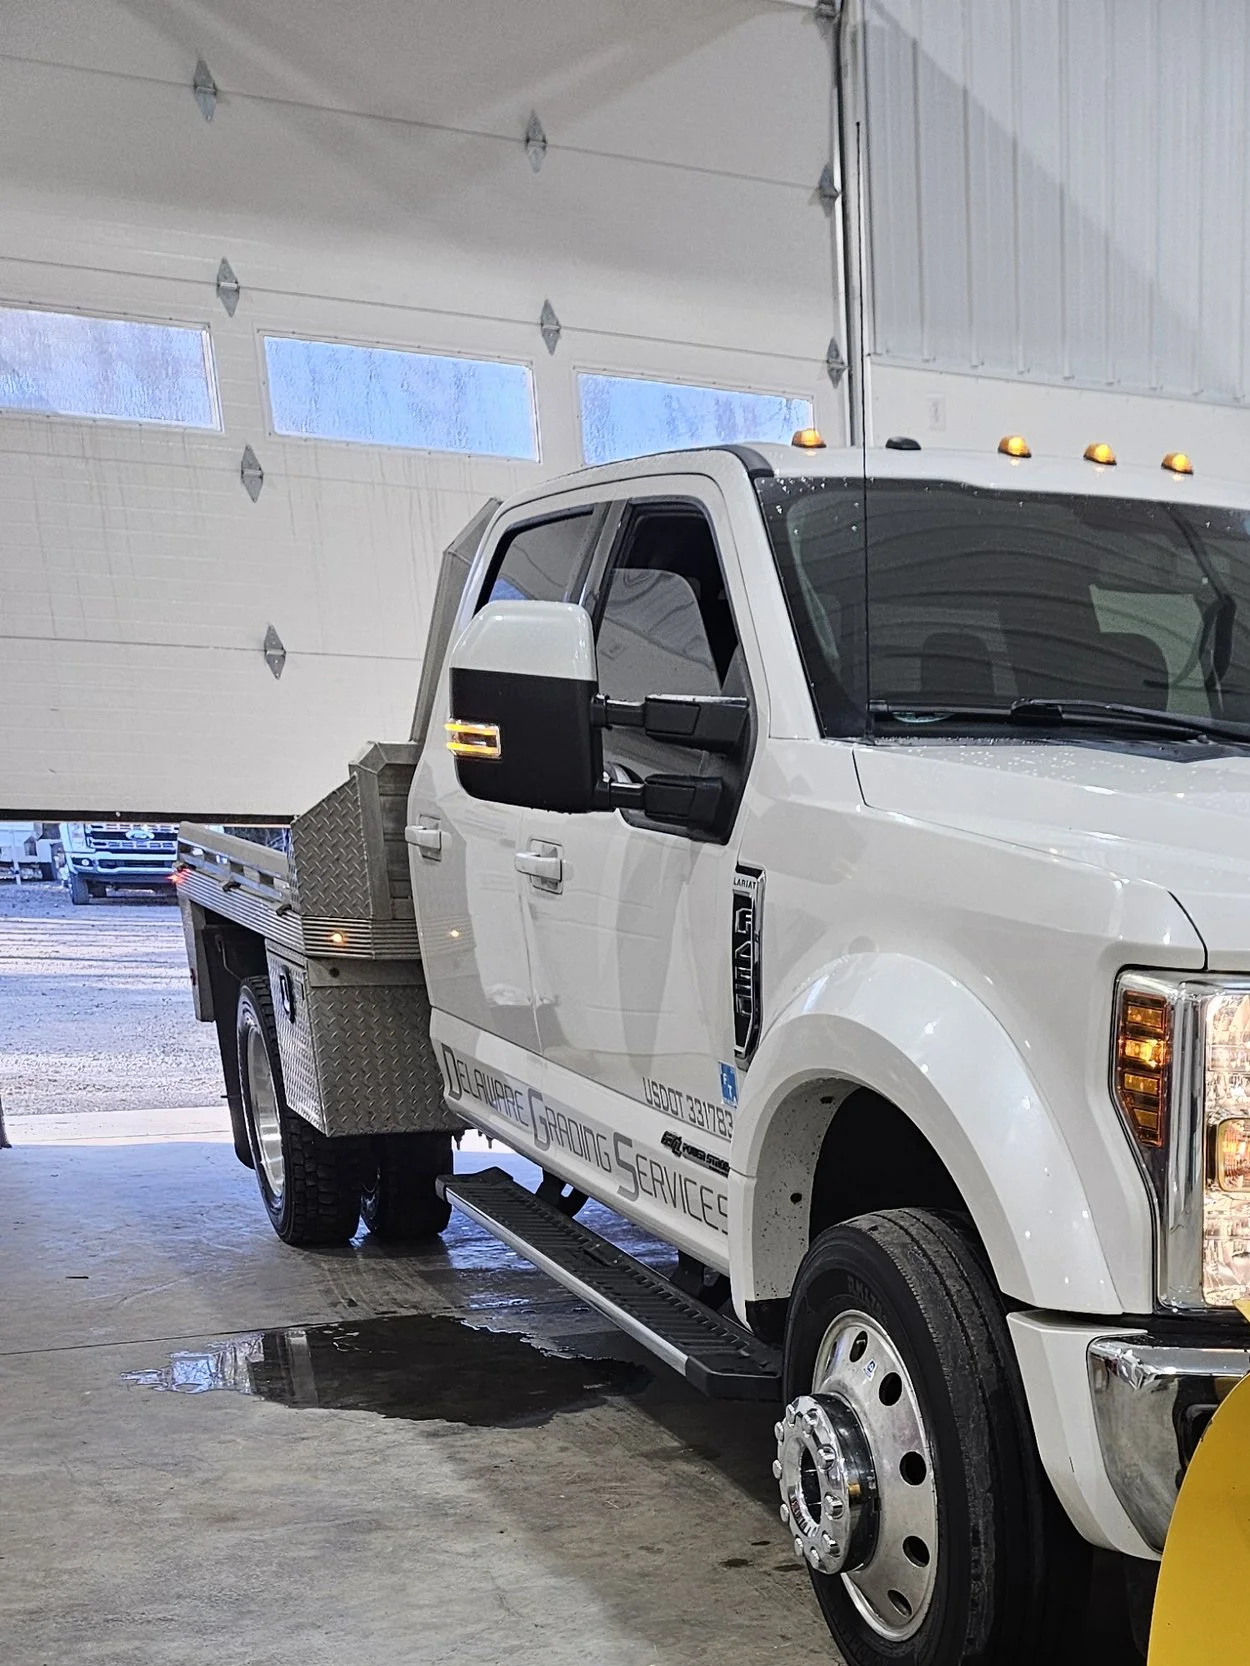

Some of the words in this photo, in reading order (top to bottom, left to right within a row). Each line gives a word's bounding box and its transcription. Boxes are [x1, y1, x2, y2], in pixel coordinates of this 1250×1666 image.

[733, 877, 756, 889] LARIAT
[441, 1043, 528, 1127] DELAWARE
[528, 1088, 611, 1173] GRADING
[643, 1076, 684, 1118] USDOT
